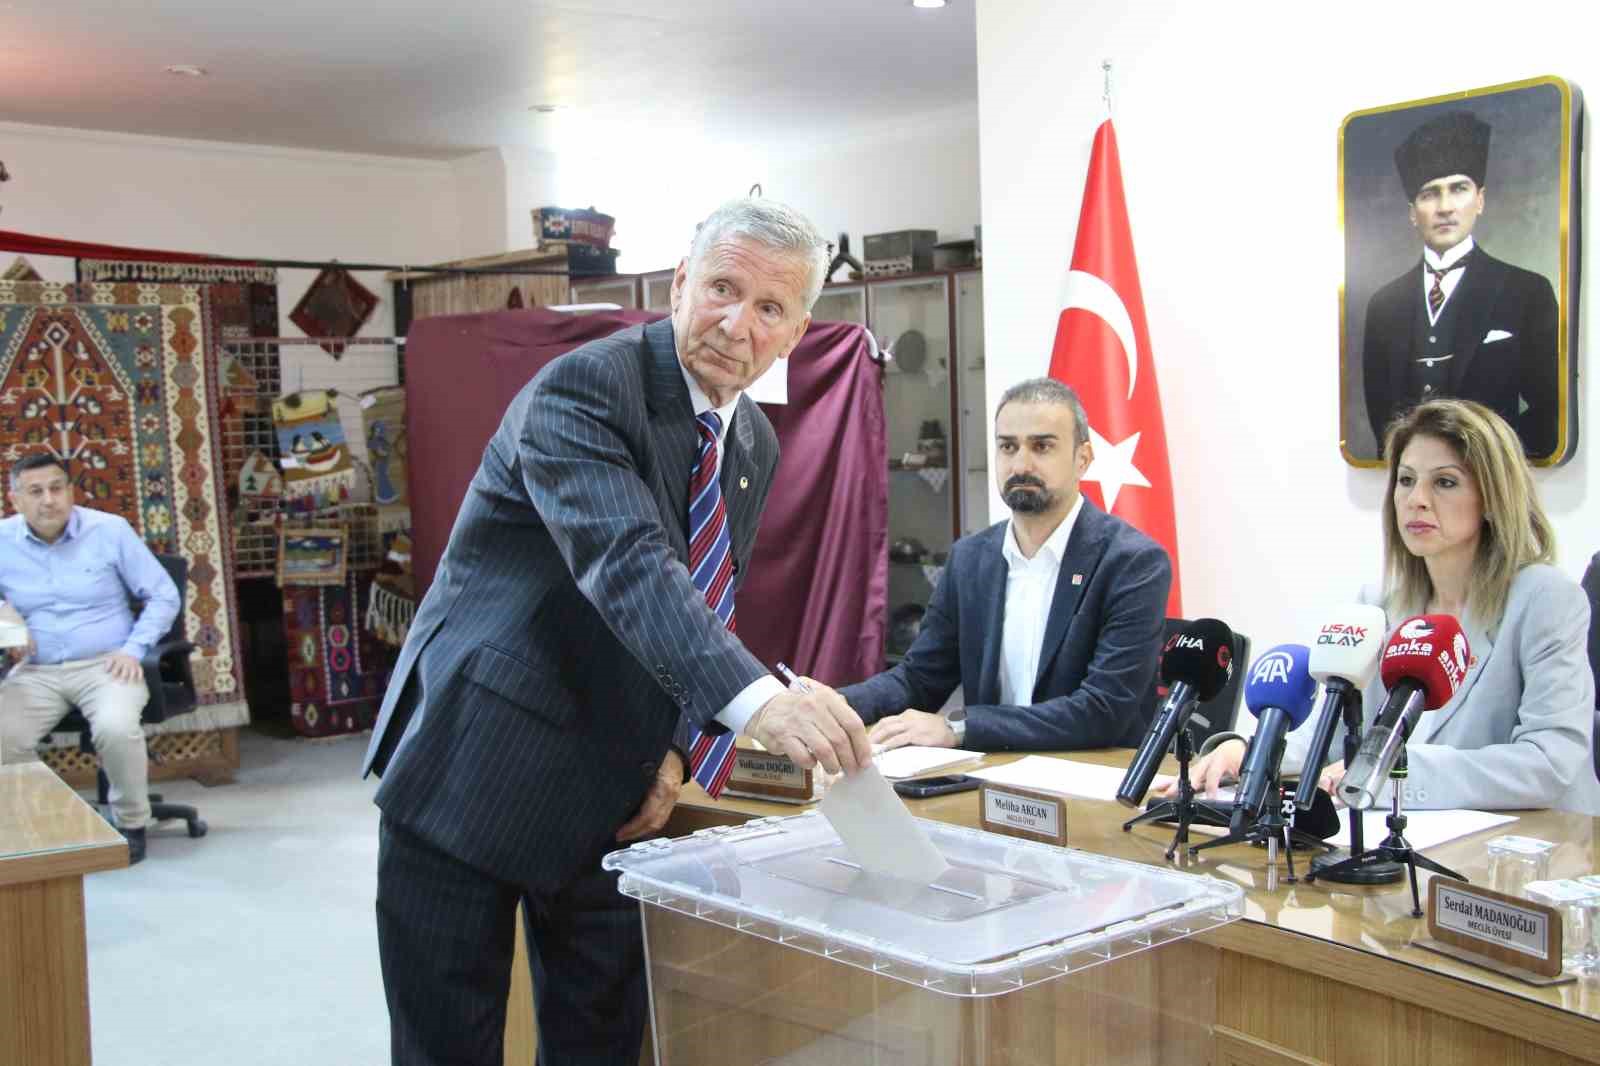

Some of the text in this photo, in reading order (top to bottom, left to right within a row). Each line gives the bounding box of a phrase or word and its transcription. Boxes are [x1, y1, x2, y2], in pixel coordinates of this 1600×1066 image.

[1317, 635, 1364, 647] OLAY
[1387, 638, 1433, 653] anka
[1251, 657, 1289, 686] AA
[994, 798, 1020, 813] Meliha
[1444, 896, 1536, 935] Serdal MADANOĞLU
